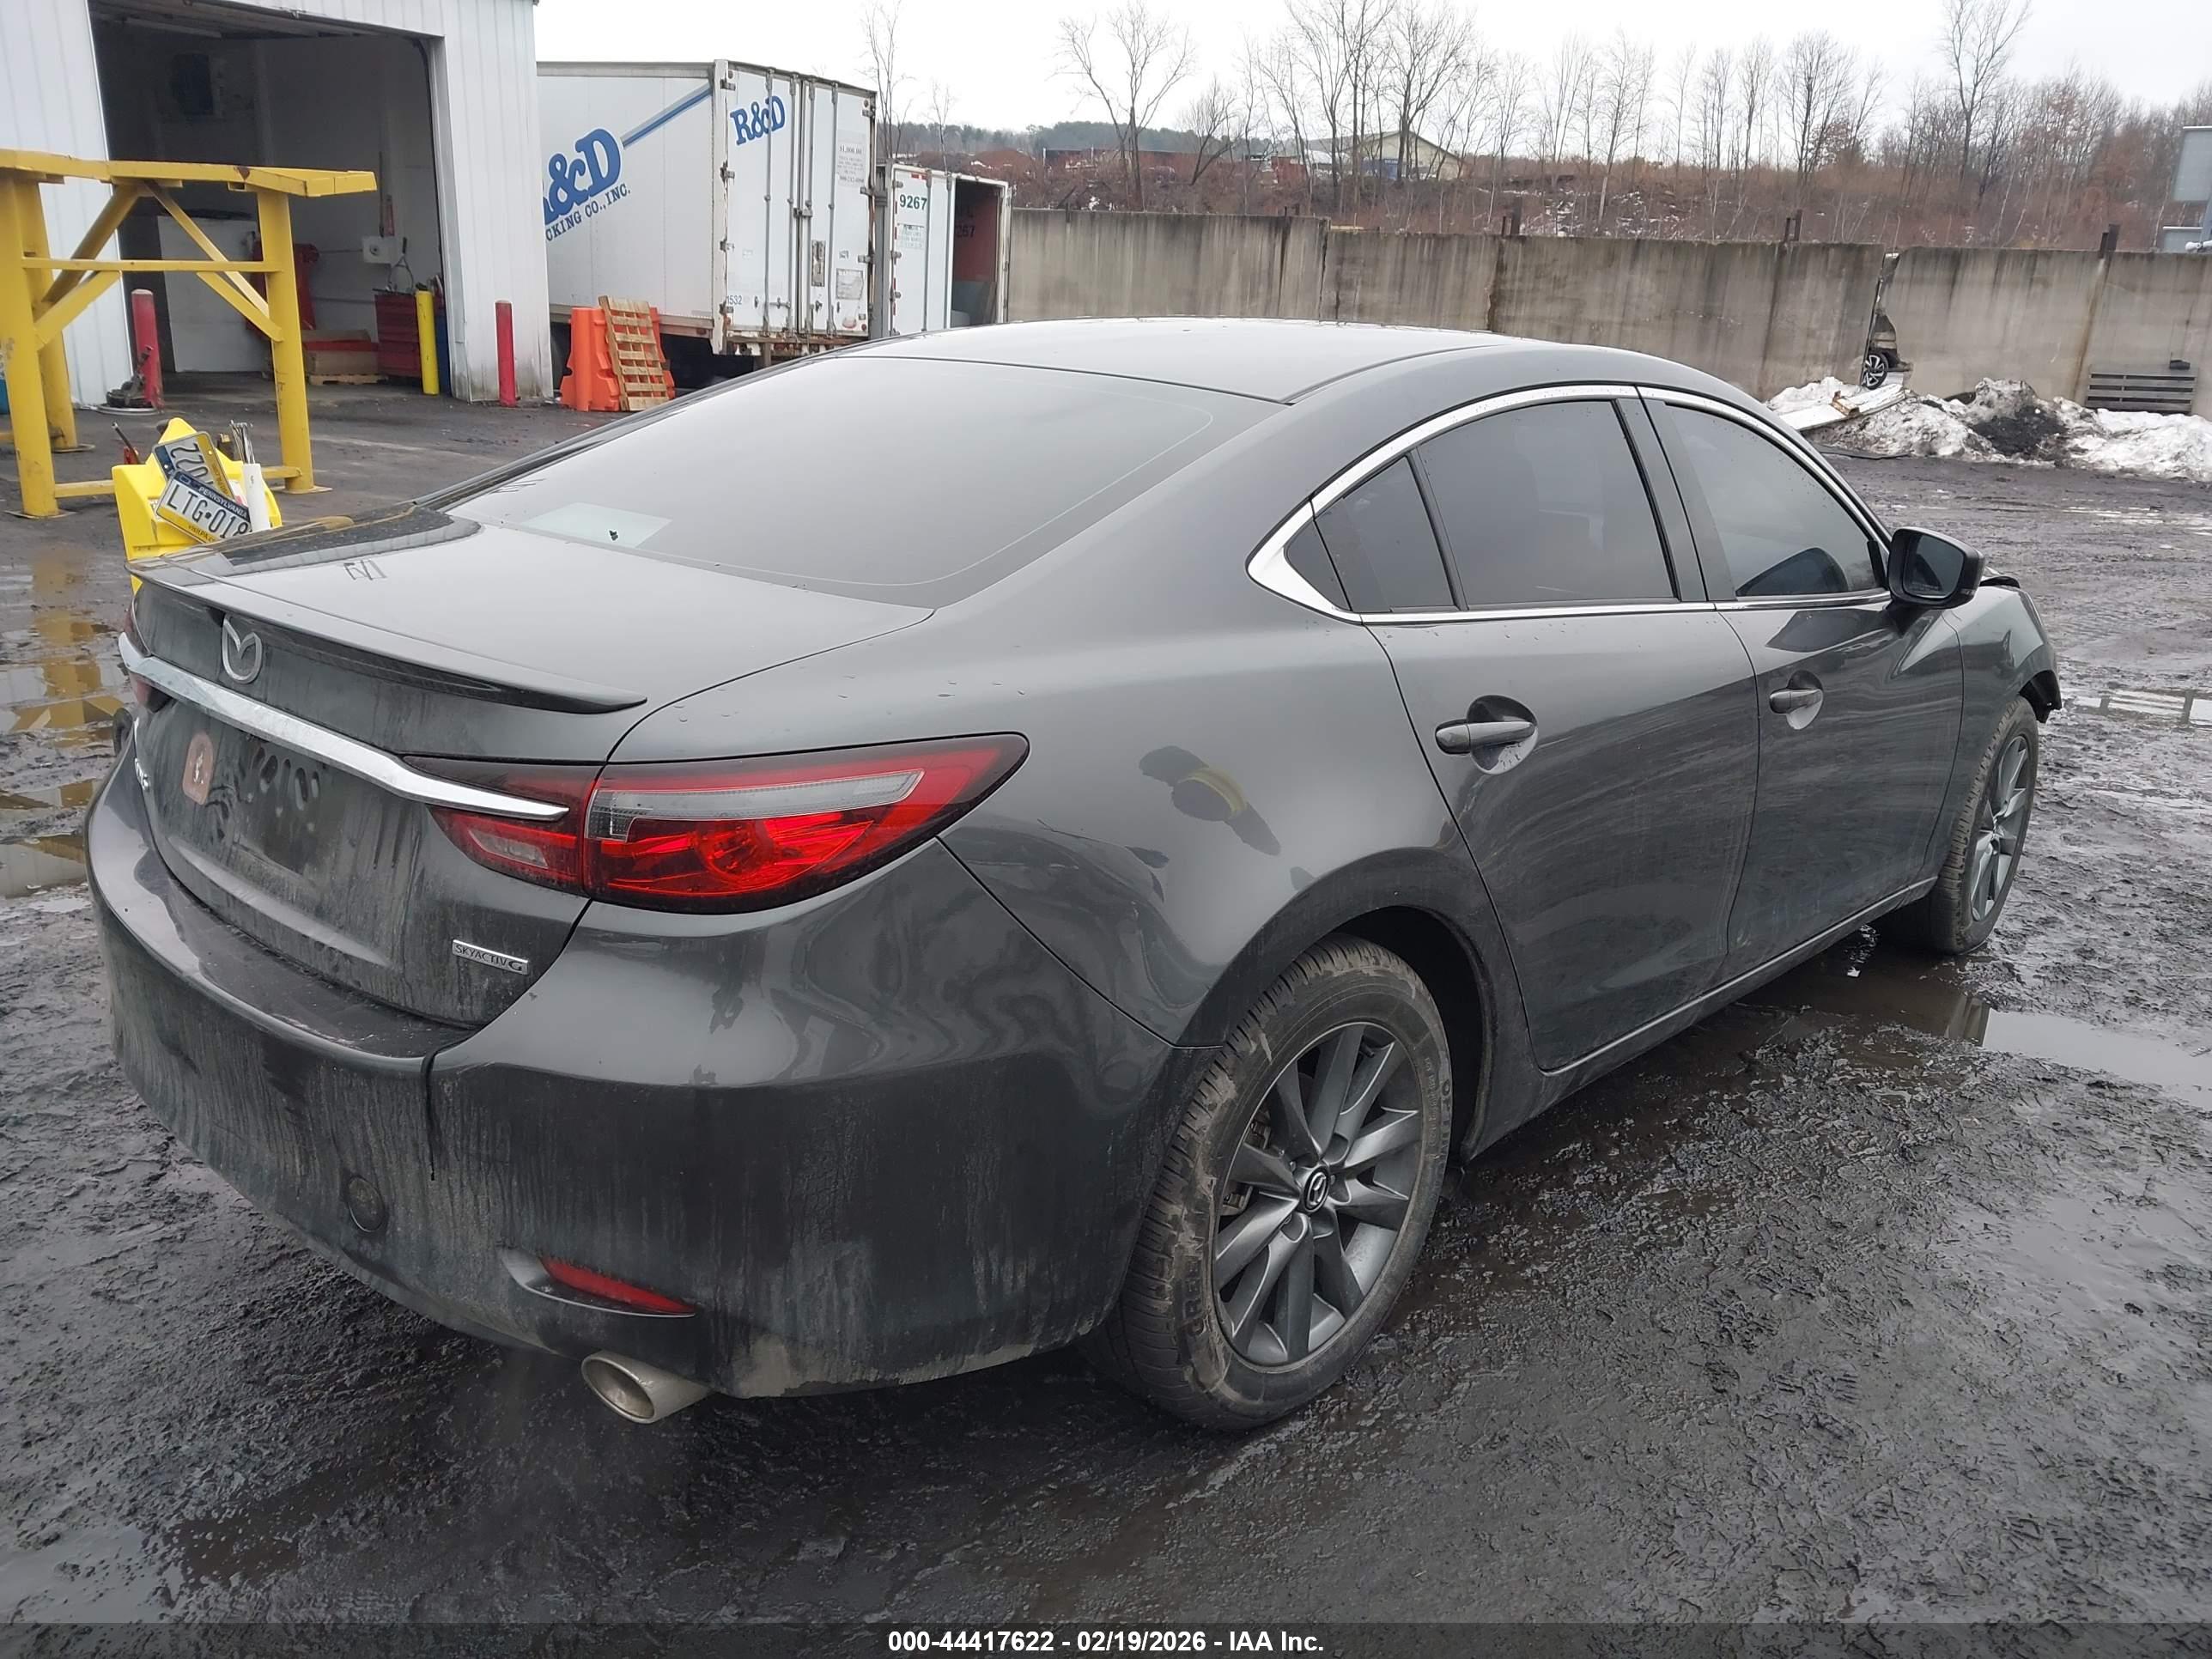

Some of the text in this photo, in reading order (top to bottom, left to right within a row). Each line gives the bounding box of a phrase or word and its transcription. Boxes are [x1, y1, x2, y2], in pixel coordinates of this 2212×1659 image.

[730, 95, 785, 145] R&D
[543, 129, 622, 225] &D
[899, 194, 927, 210] 9267
[198, 486, 247, 519] PENNSYLVANIA
[455, 945, 507, 966] SKYACTIV
